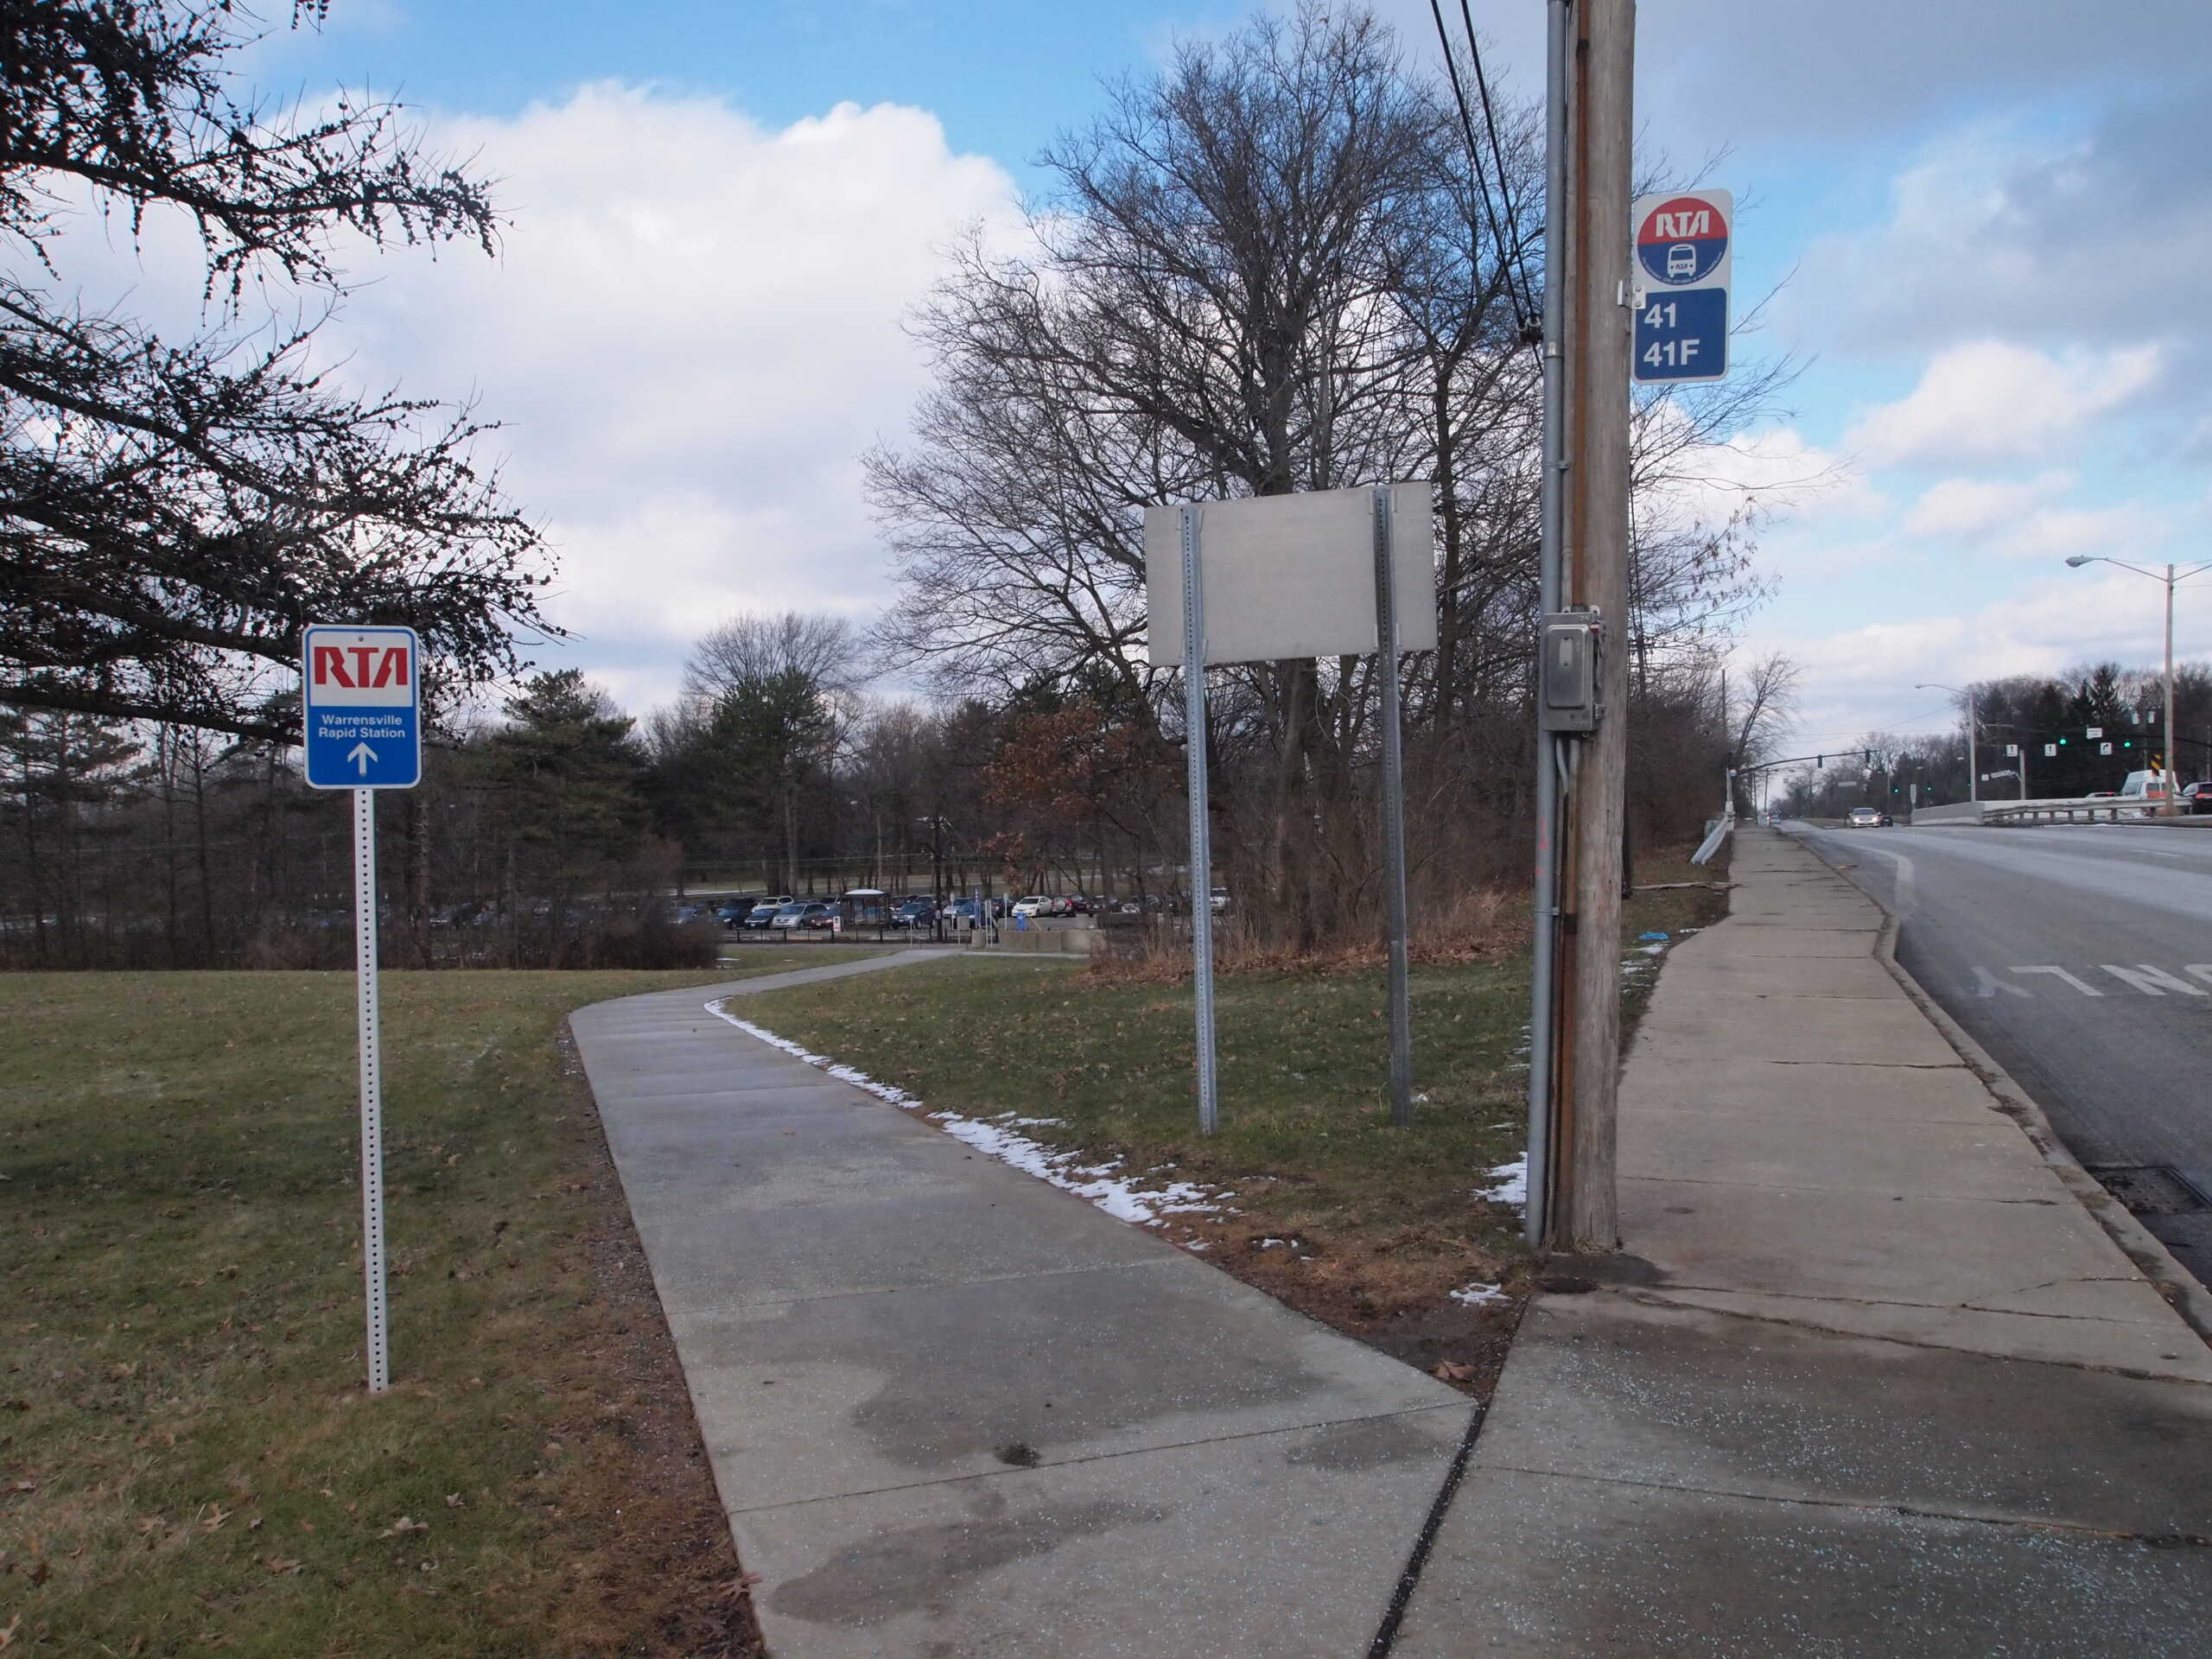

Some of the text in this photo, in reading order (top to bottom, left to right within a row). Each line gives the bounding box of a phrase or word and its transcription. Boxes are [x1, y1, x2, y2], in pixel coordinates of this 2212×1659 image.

[1656, 210, 1710, 238] RTA
[1643, 302, 1676, 329] 41
[1643, 339, 1700, 367] 41F
[314, 646, 408, 688] RTA
[318, 727, 406, 740] Rapid Station
[321, 714, 403, 726] Warrensville
